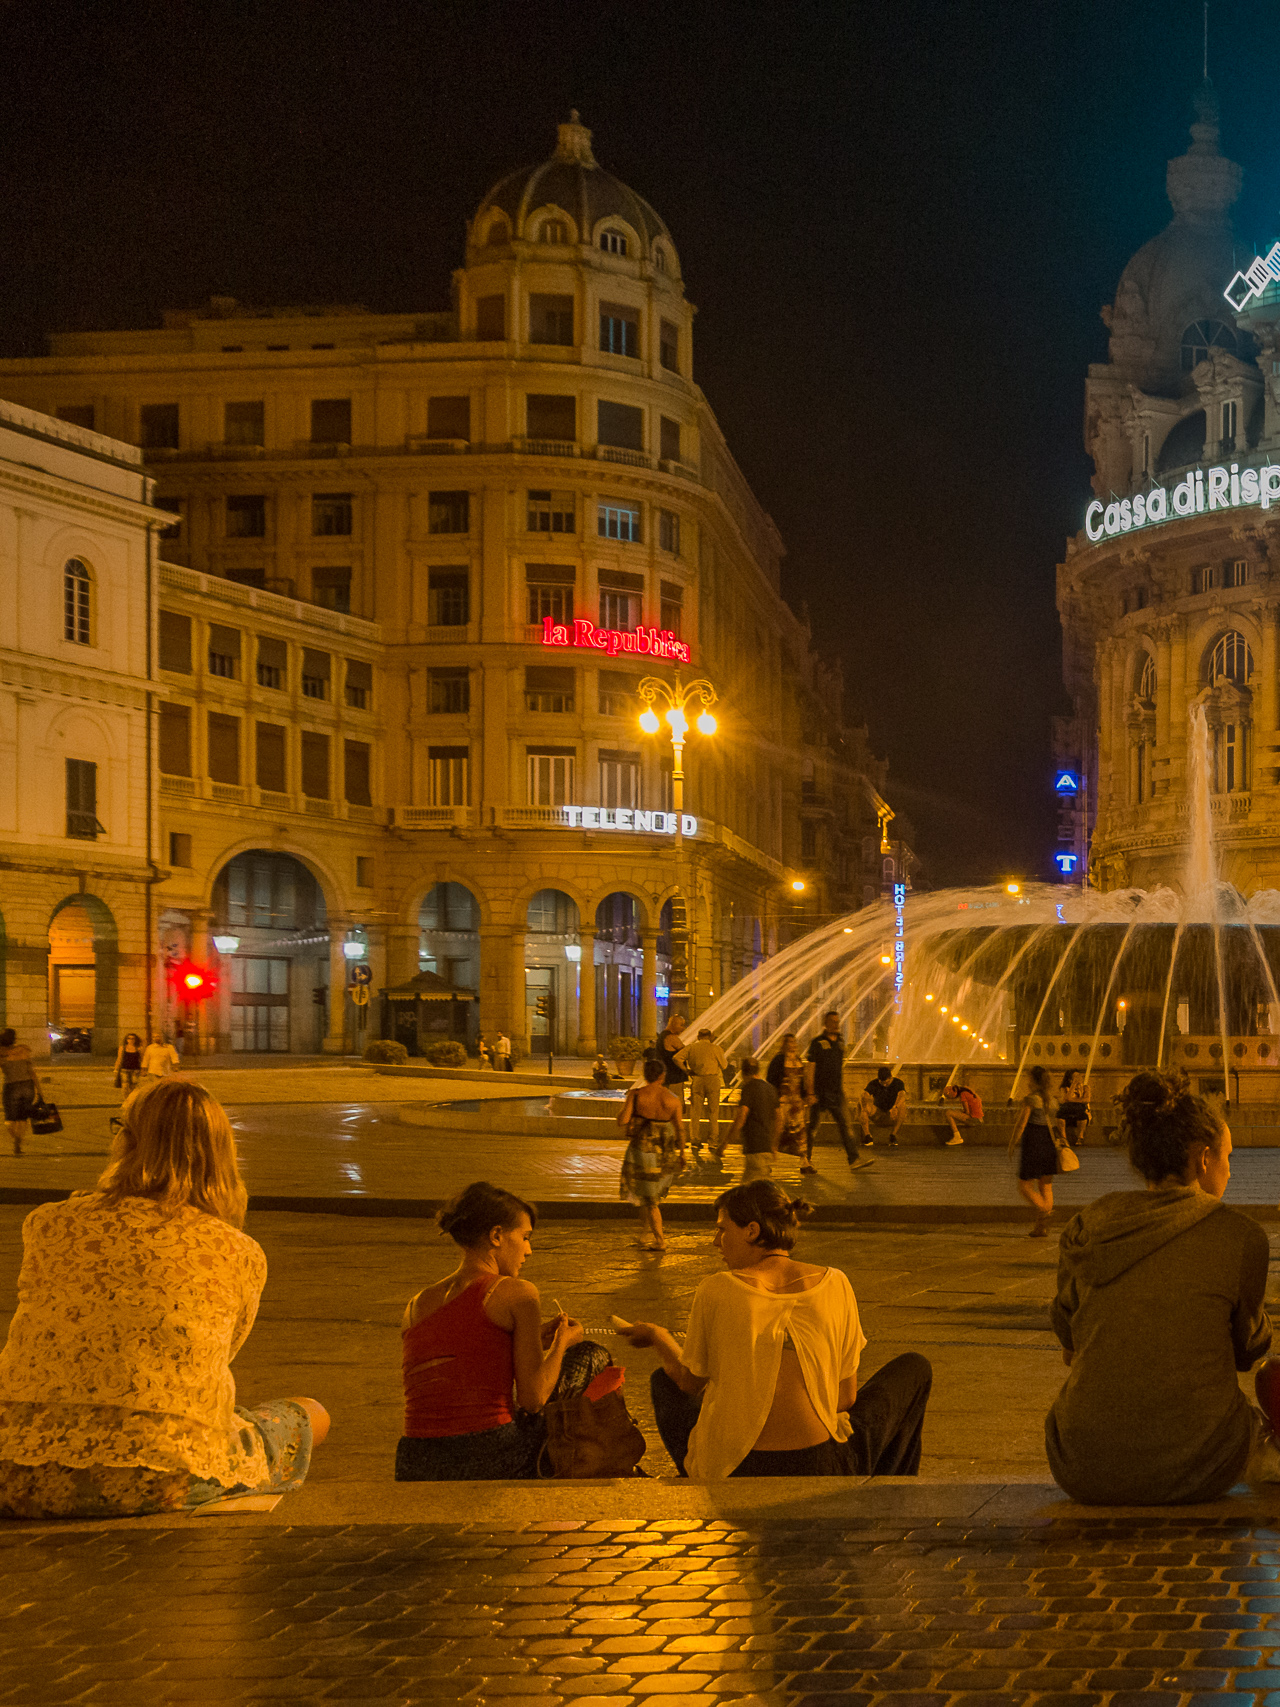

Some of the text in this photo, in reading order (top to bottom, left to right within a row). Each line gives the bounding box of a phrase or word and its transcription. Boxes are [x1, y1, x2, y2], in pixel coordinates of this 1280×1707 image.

[1085, 487, 1168, 542] Cassa
[1173, 469, 1203, 515] di
[542, 616, 691, 662] la Repubblica
